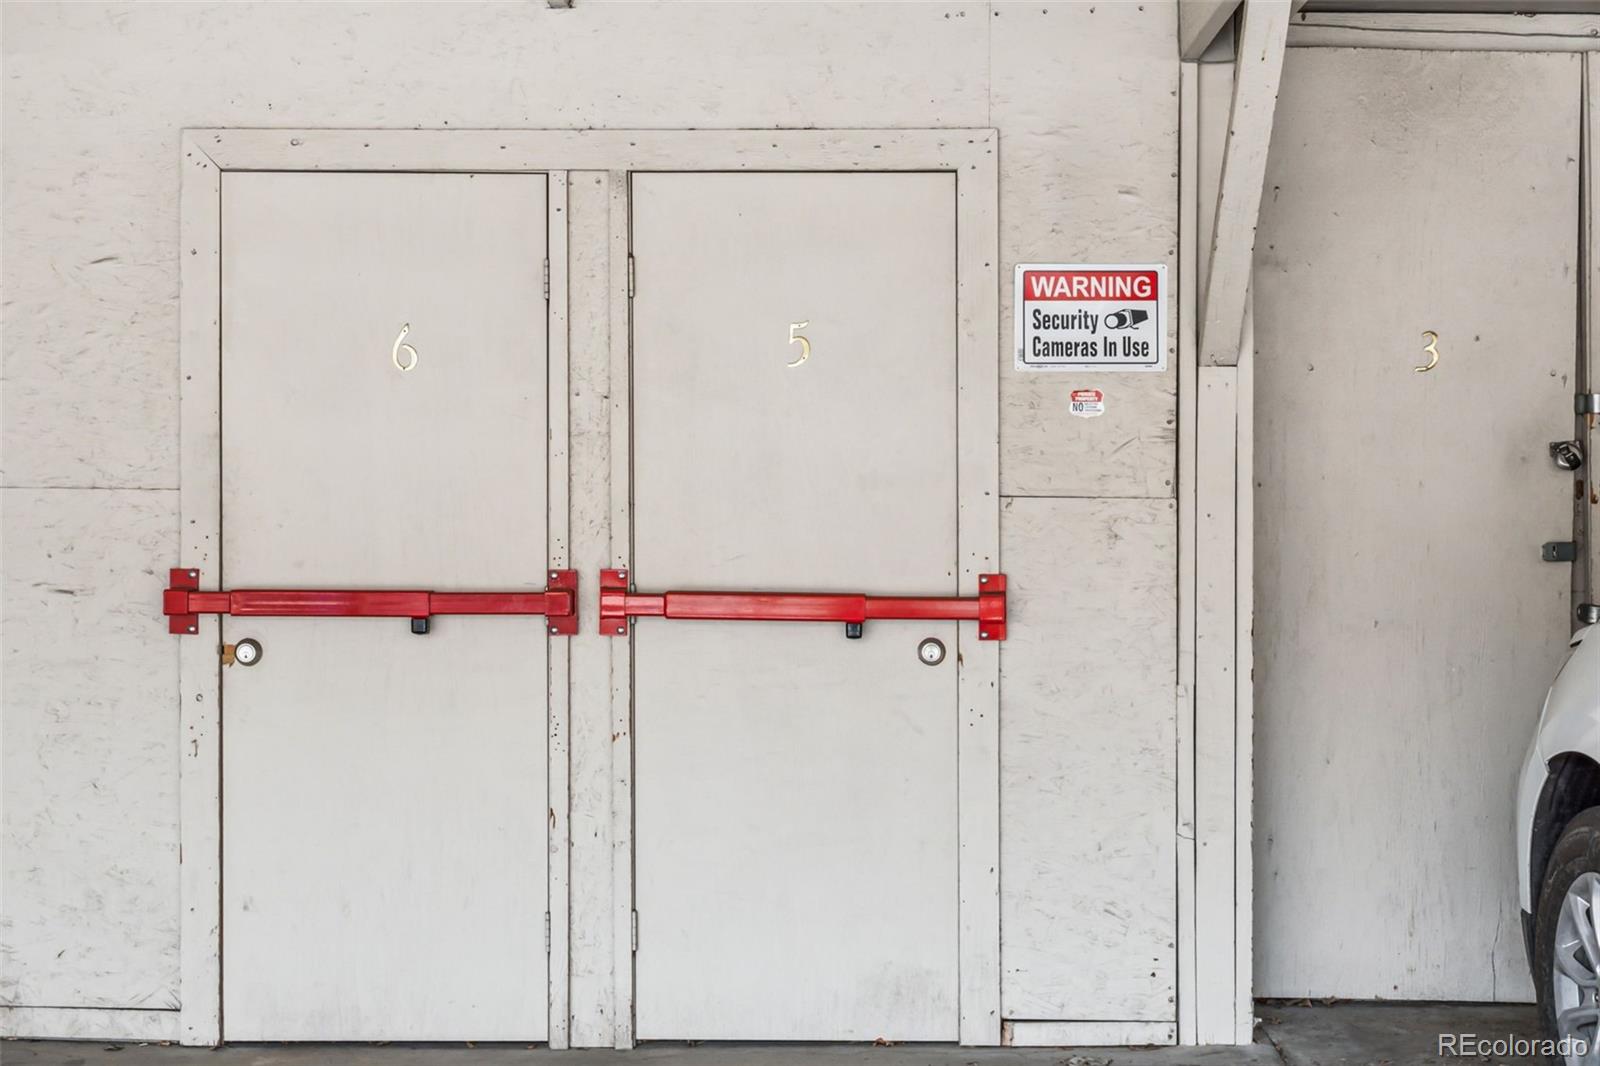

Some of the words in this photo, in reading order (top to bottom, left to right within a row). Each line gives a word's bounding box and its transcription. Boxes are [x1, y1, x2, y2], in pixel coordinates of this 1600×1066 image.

[1030, 275, 1152, 298] WARNING
[1032, 308, 1099, 334] Security
[393, 322, 418, 371] 6
[787, 320, 811, 368] 5
[1032, 335, 1098, 358] Cameras
[1103, 336, 1117, 357] In
[1122, 336, 1149, 357] Use
[1415, 330, 1439, 372] 3
[1072, 402, 1084, 412] NO
